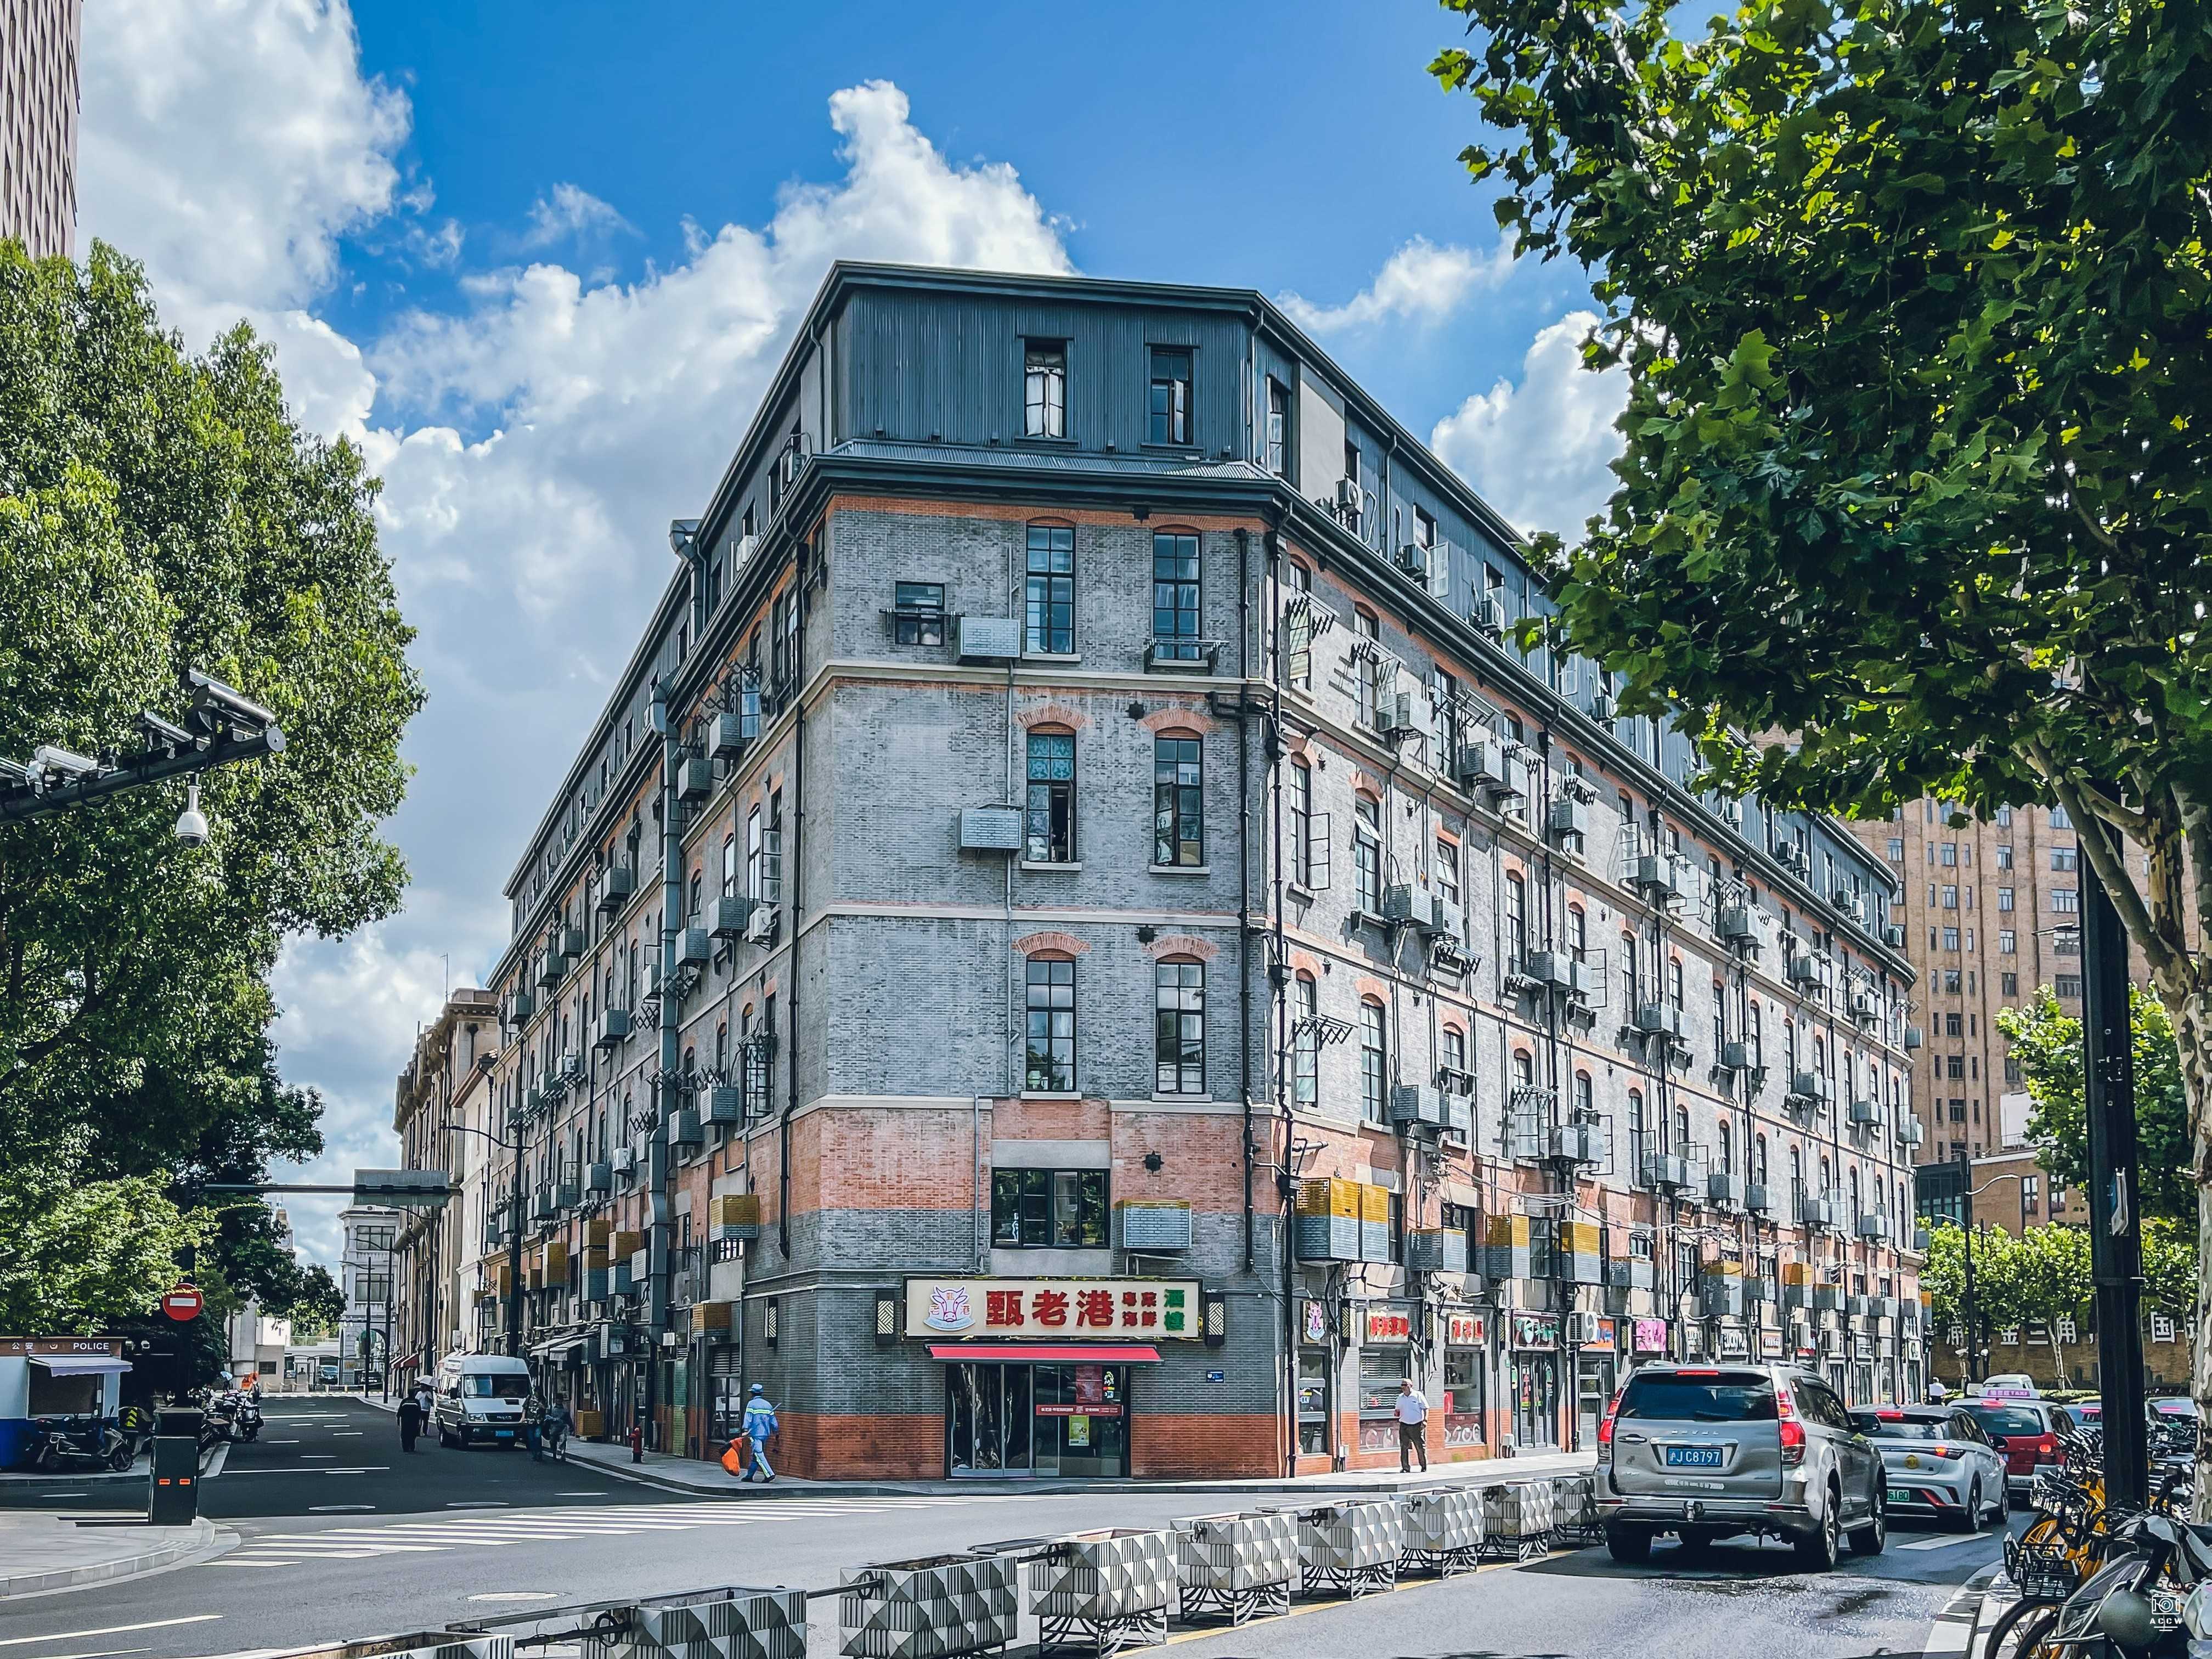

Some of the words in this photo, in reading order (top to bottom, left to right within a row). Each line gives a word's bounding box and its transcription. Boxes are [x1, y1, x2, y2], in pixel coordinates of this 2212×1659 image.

[986, 1289, 1114, 1327] 甄老港
[12, 1342, 33, 1350] 公安
